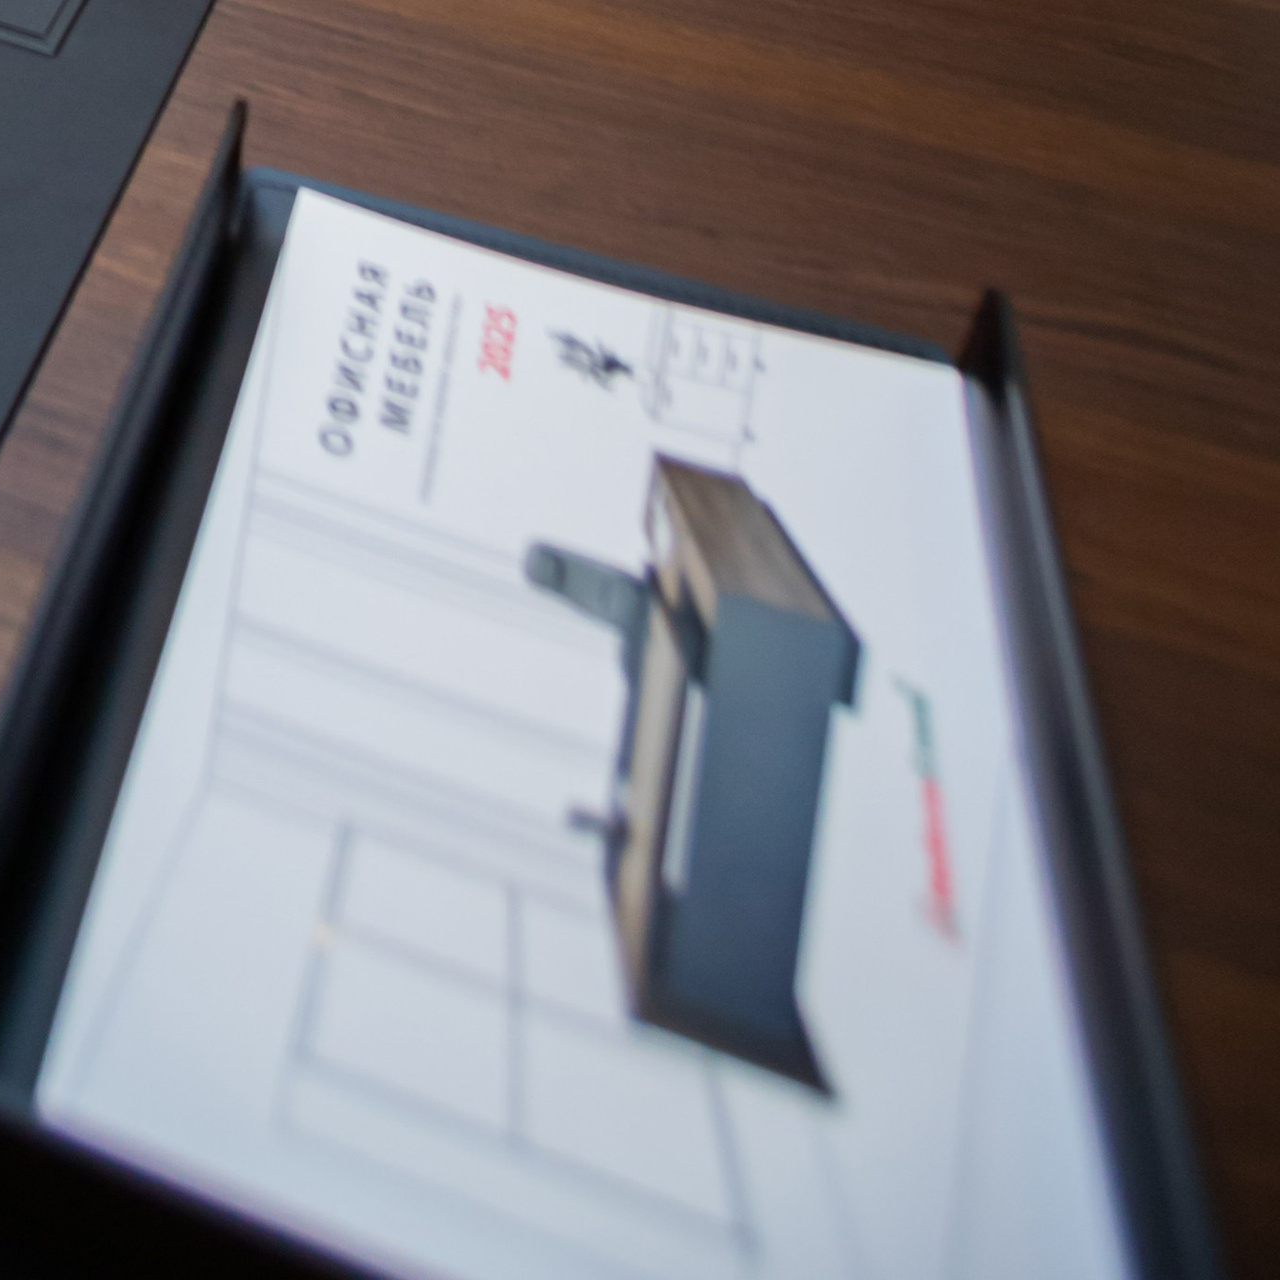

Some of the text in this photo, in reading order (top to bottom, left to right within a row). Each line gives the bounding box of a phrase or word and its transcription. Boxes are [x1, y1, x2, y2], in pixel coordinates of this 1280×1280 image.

[318, 260, 390, 459] ОФИСНАЯ
[379, 278, 438, 436] МЕБЕЛЬ
[477, 302, 517, 382] 2025
